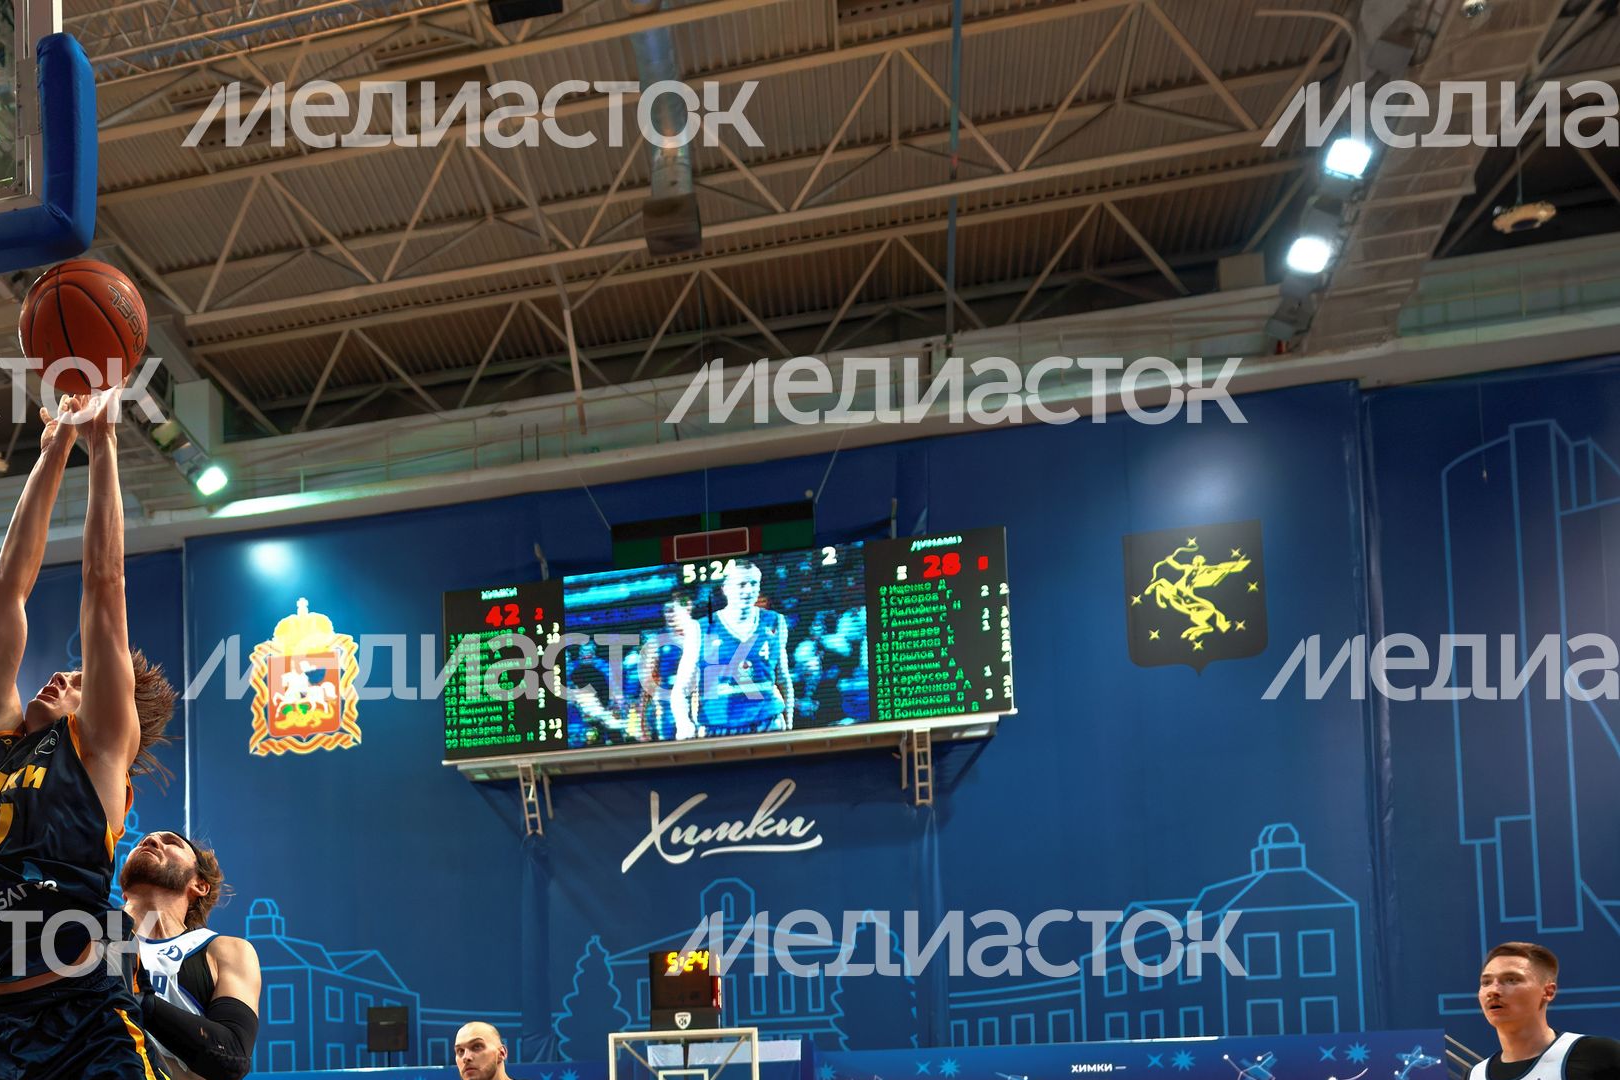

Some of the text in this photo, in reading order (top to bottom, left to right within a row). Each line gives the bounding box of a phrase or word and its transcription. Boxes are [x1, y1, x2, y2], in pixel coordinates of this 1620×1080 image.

[821, 546, 838, 565] 2
[923, 552, 962, 579] 28
[485, 602, 521, 627] 42
[621, 778, 823, 873] Химки
[1071, 1063, 1113, 1074] ХИМКИ
